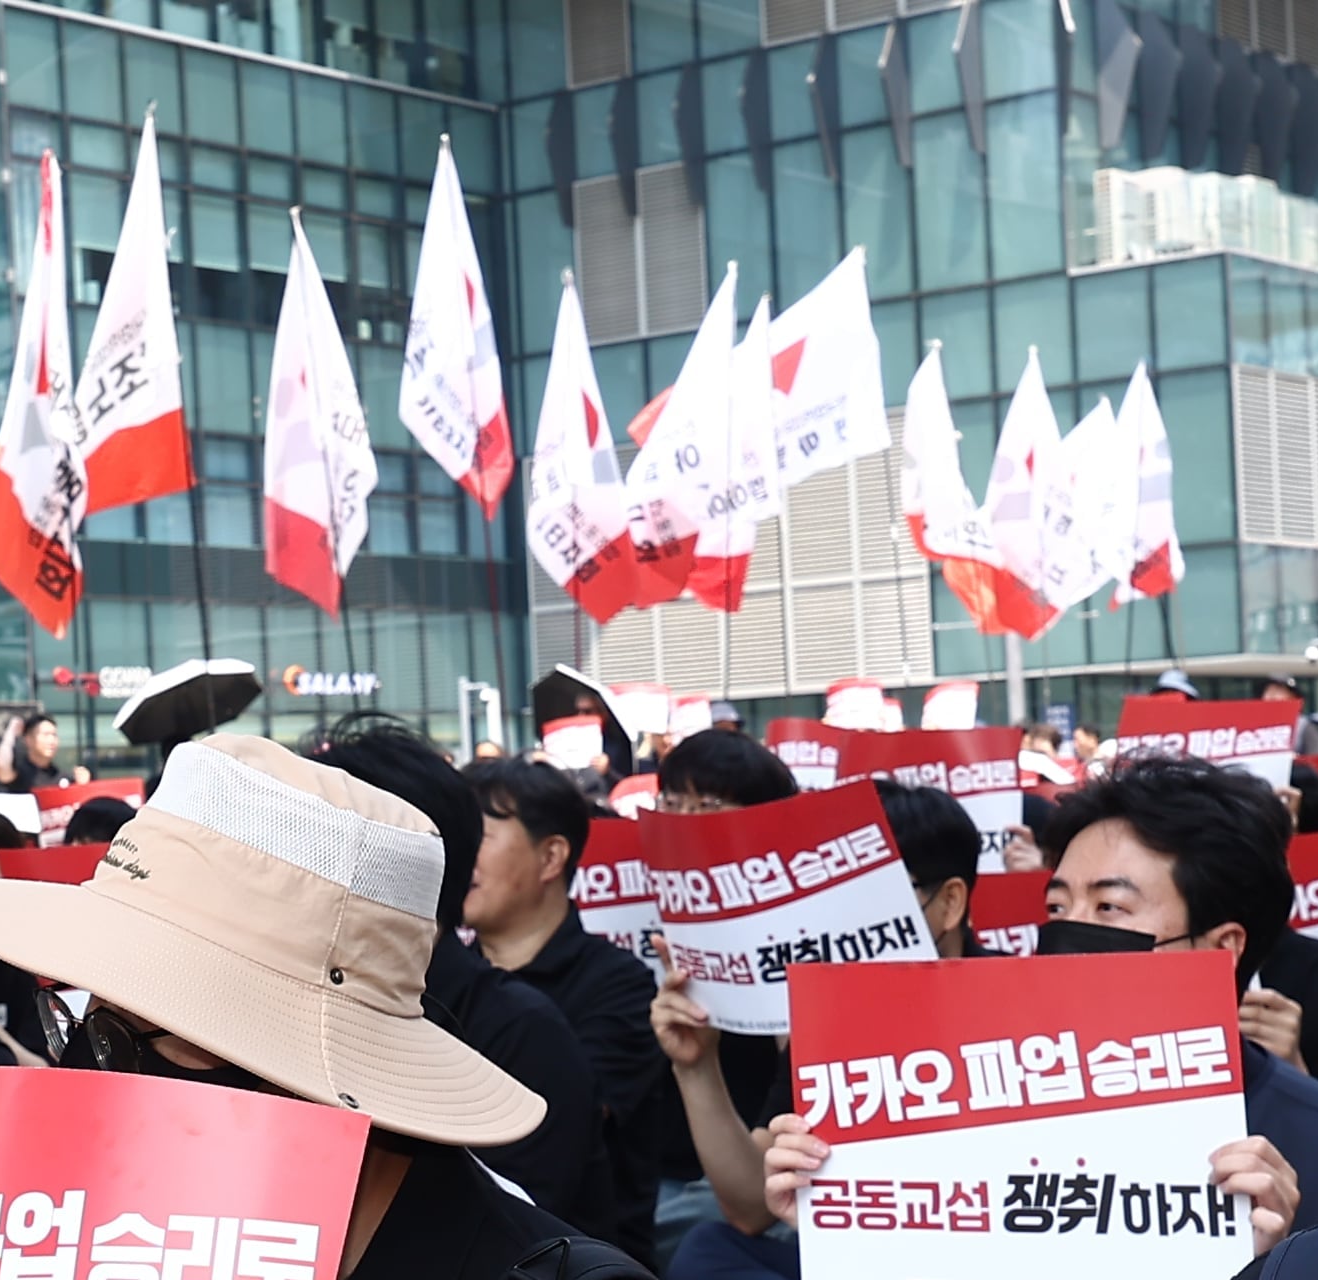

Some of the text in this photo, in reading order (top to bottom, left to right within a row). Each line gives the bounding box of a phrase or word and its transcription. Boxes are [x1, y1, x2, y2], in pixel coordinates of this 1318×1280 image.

[949, 759, 1018, 795] 승리로
[709, 850, 794, 906] 파업
[789, 822, 893, 890] 승리로
[797, 1025, 1233, 1130] 카카오 파업 승리로
[809, 1172, 1237, 1238] 공동교섭 쟁취 하자!
